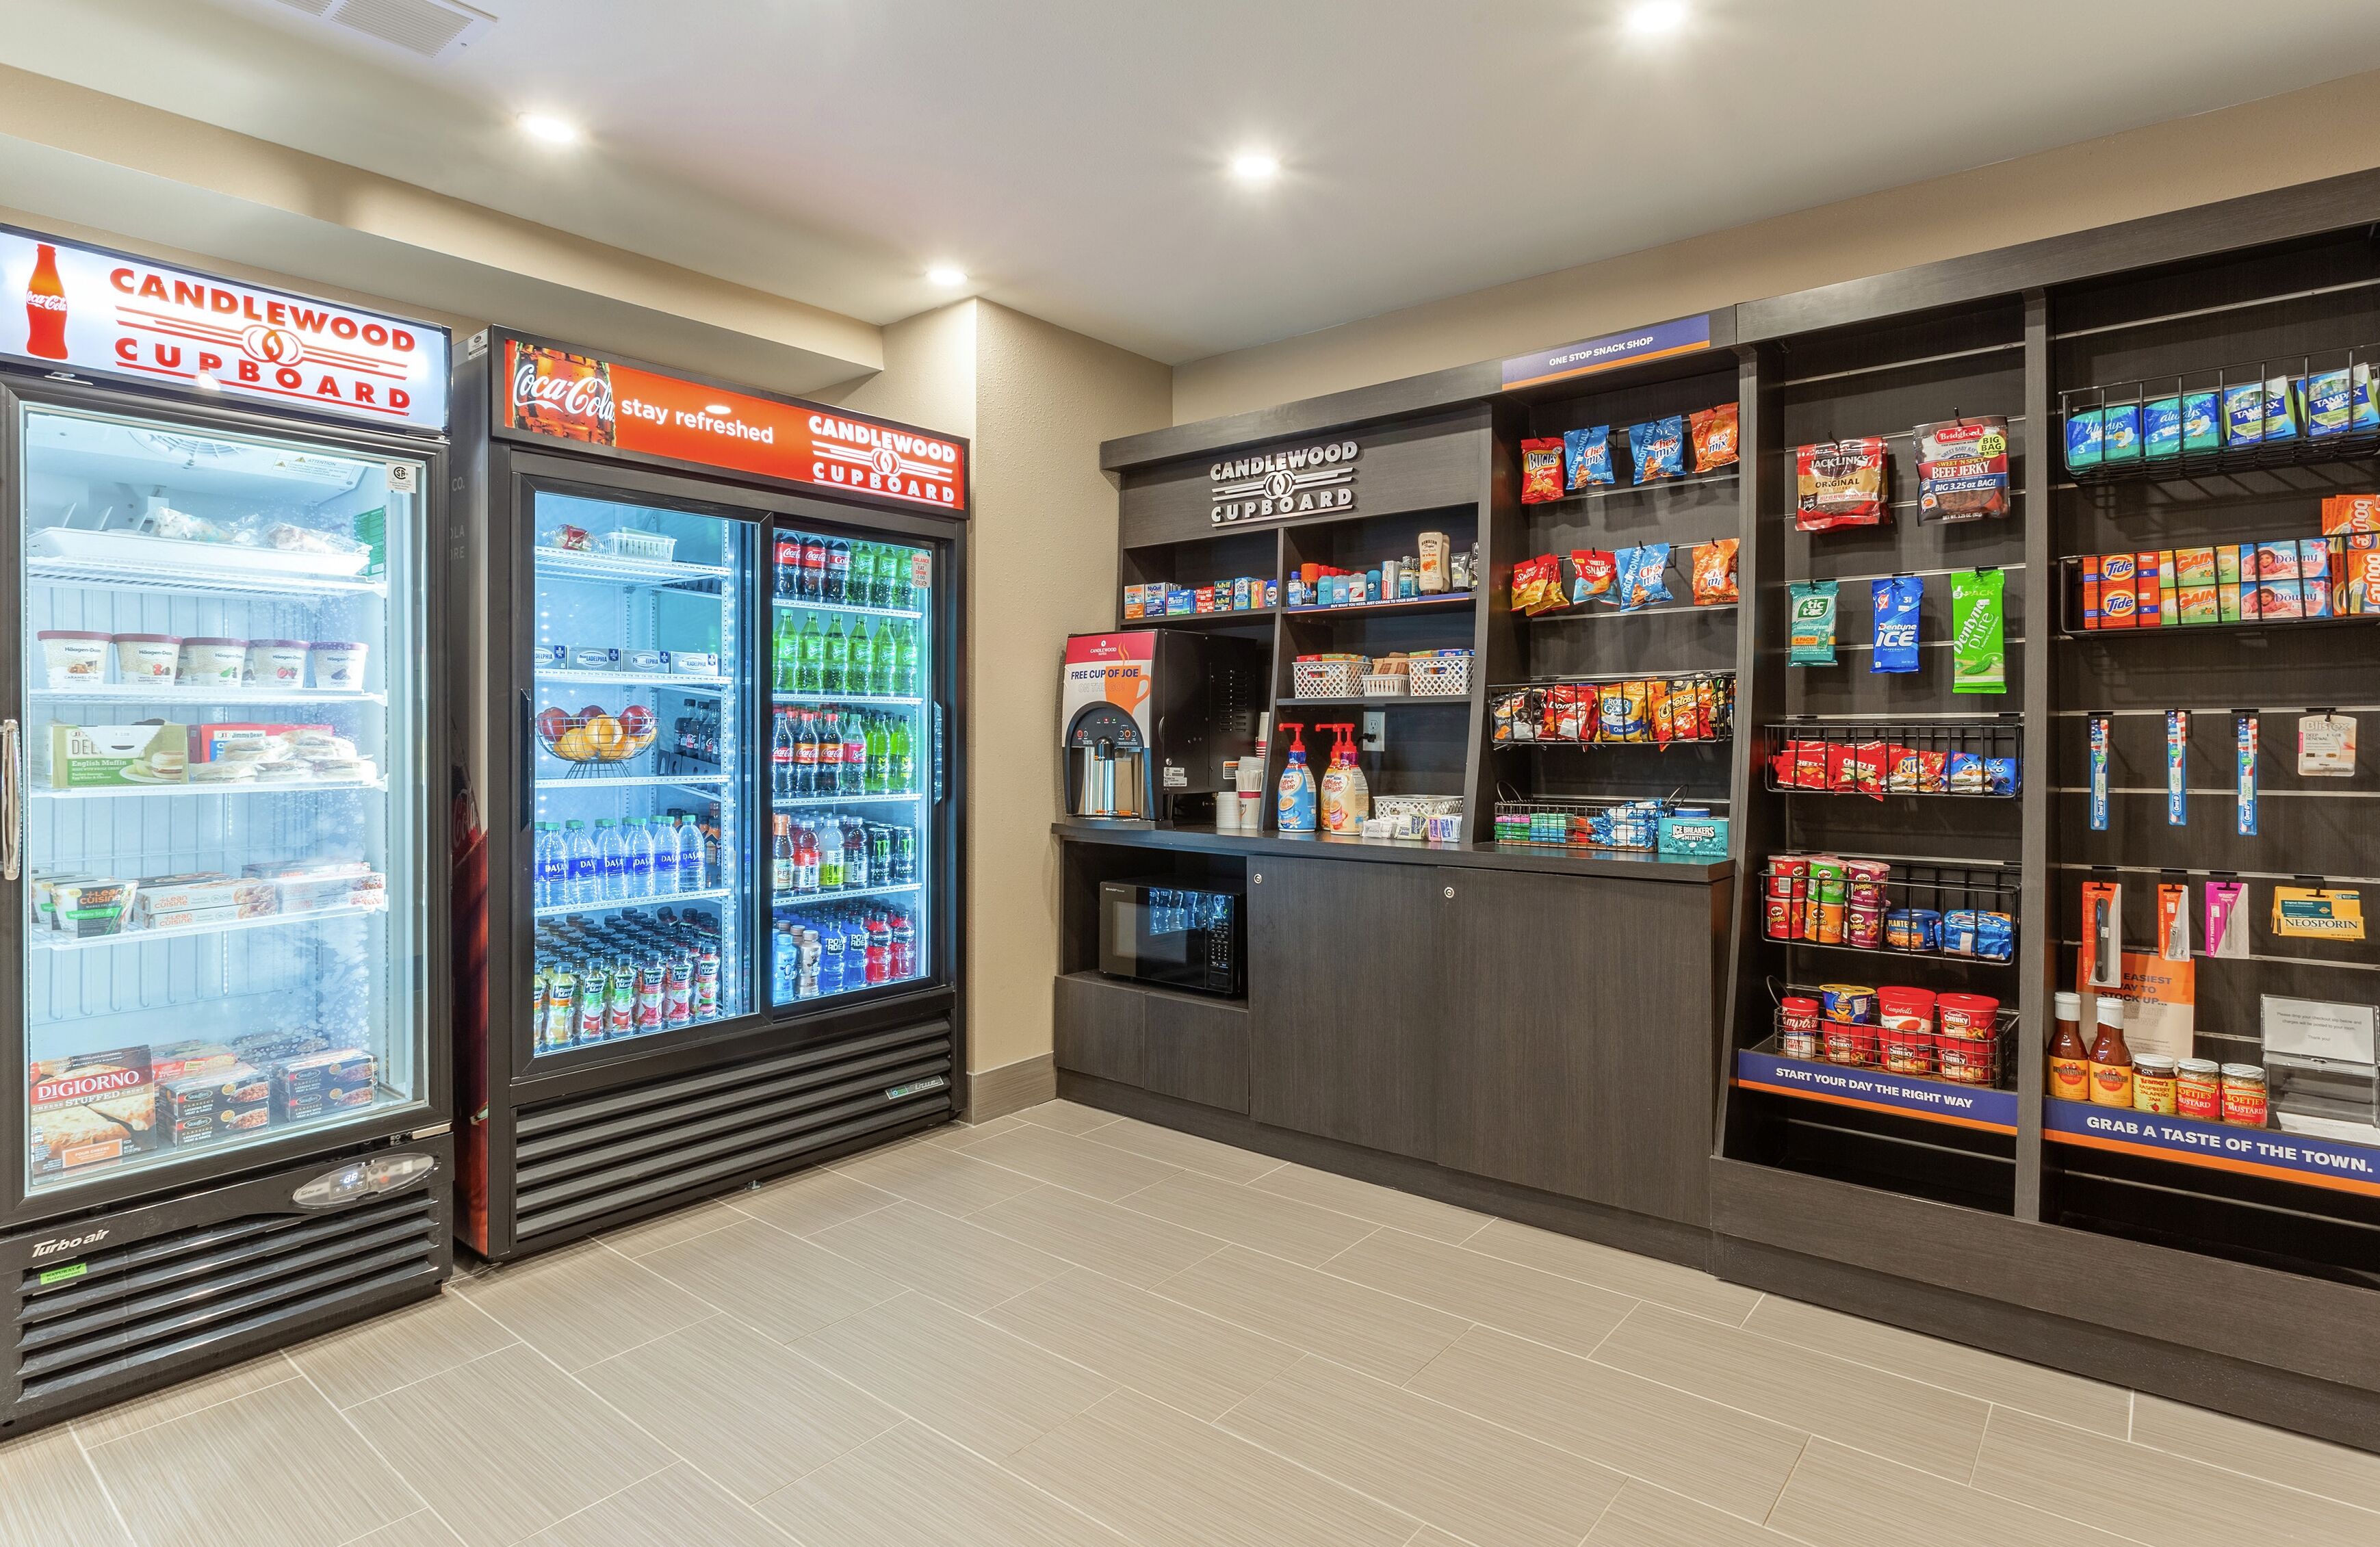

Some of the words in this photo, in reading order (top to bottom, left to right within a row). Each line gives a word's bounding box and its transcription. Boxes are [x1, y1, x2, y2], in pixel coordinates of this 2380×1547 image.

[25, 290, 68, 312] Coca-Cola
[109, 268, 416, 353] CANDLEWOOD
[1549, 355, 1568, 366] ONE
[1569, 350, 1592, 362] STOP
[1594, 342, 1625, 356] SNACK
[1627, 336, 1653, 349] SHOP
[115, 337, 411, 409] CUPBOARD
[513, 364, 617, 423] Coca-Cola
[621, 398, 669, 425] stay
[675, 411, 774, 444] refreshed
[810, 415, 955, 463] CANDLEWOOD
[1653, 435, 1677, 449] Chex
[1982, 436, 2000, 444] BIG
[2151, 432, 2158, 443] 3
[1584, 445, 1605, 458] Chex
[1655, 445, 1677, 459] mix
[1708, 439, 1728, 453] mix
[2078, 444, 2084, 454] 3
[308, 458, 336, 467] ATTENTION
[1210, 441, 1358, 482] CANDLEWOOD
[1527, 452, 1557, 471] BUGLES
[1586, 454, 1605, 466] mix
[1811, 458, 1835, 469] JACK
[1836, 455, 1869, 465] LINK'S
[1932, 467, 1957, 480] BEEF
[1957, 460, 1991, 478] JERKY
[813, 463, 955, 504] CUPBOARD
[1815, 478, 1860, 488] ORIGINAL
[1935, 484, 1949, 492] BIG
[1950, 482, 1967, 490] 3.25
[1977, 478, 1996, 487] BAG!
[1211, 488, 1352, 523] CUPBOARD
[2352, 499, 2375, 548] bounce
[2106, 559, 2133, 575] Tide
[2177, 552, 2214, 573] GAIN
[1640, 562, 1664, 578] Chex
[1807, 599, 1824, 608] tic
[2106, 595, 2133, 611] Tide
[2179, 588, 2217, 610] GAIN
[1802, 608, 1824, 616] tac
[1878, 623, 1917, 632] Dentyne
[1968, 612, 1995, 650] pure
[1876, 631, 1915, 647] ICE
[1072, 671, 1087, 680] FREE
[1089, 669, 1106, 679] CUP
[1108, 669, 1120, 677] OF
[1122, 668, 1139, 677] JOE
[1078, 683, 1089, 692] ON
[1091, 682, 1106, 692] THE
[1672, 824, 1683, 835] ICE
[1683, 826, 1715, 837] BREAKERS
[1854, 883, 1872, 892] Pringles
[1770, 915, 1785, 925] Pringles
[2286, 918, 2358, 928] NEOSPORIN
[2123, 972, 2172, 985] EASIEST
[2140, 985, 2156, 993] TO
[2100, 991, 2140, 1003] STOCK
[2143, 997, 2167, 1006] UP...
[1944, 1014, 1968, 1024] CHUNKY
[1776, 1067, 1812, 1082] START
[1814, 1074, 1847, 1087] YOUR
[1849, 1078, 1874, 1092] DAY
[1874, 1084, 1899, 1097] THE
[1902, 1088, 1941, 1104] RIGHT
[1943, 1095, 1974, 1108] WAY
[2138, 1084, 2170, 1093] RASPBERRY
[2140, 1077, 2169, 1087] Kramer's
[33, 1102, 64, 1112] CHEESE
[65, 1091, 120, 1107] STUFFED
[2227, 1093, 2264, 1106] BOETJE'S
[2228, 1102, 2264, 1115] MUSTARD
[2086, 1116, 2138, 1134] GRAB
[2143, 1126, 2157, 1138] A
[2161, 1128, 2221, 1149] TASTE
[2225, 1138, 2253, 1153] OF
[2257, 1143, 2297, 1160] THE
[2302, 1149, 2373, 1173] TOWN.
[31, 1237, 82, 1258] Turbo
[83, 1229, 109, 1244] air
[46, 1267, 76, 1277] NATURAL
